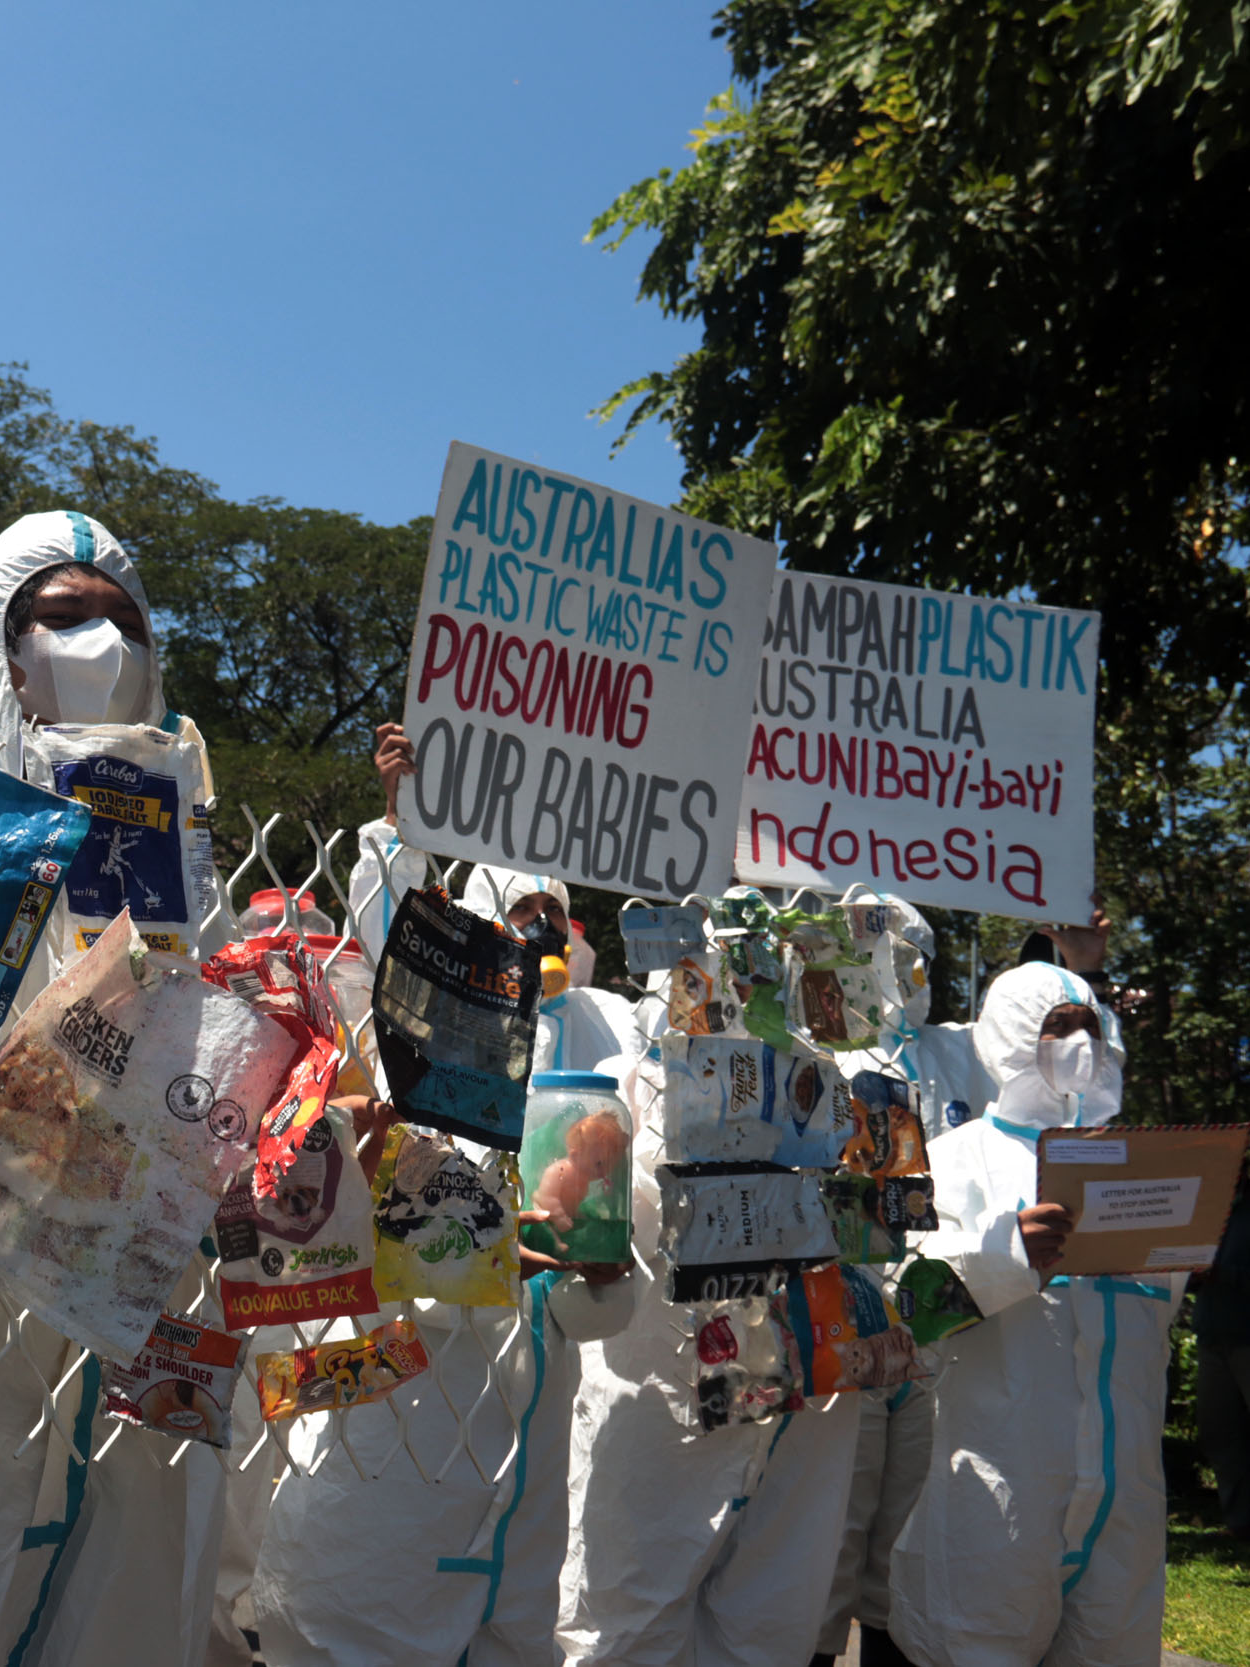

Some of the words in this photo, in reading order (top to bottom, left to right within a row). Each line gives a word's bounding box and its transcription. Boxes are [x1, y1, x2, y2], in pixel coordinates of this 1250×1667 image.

[453, 459, 734, 610] AUSTRALIA'S
[439, 540, 578, 634] PLASTIC
[586, 579, 687, 665] WASTE
[694, 620, 733, 677] IS
[917, 598, 1092, 695] PLASTIK
[417, 614, 653, 749] POISONING
[752, 658, 986, 749] USTRALIA
[94, 758, 138, 784] Cerebos
[748, 723, 869, 798] ACUNI
[88, 789, 145, 813] IODISED
[416, 717, 526, 861] OUR
[525, 748, 718, 898] BABIES
[42, 862, 59, 882] 60
[400, 920, 522, 999] SavourLife
[71, 996, 135, 1055] CHICKEN
[470, 989, 519, 1008] DIFFERENCE
[58, 1008, 129, 1076] TENDERS
[449, 1068, 489, 1087] FLAVOUR
[730, 1050, 746, 1113] Fancy
[745, 1052, 759, 1103] Feast
[741, 1189, 753, 1246] MEDIUM
[1101, 1187, 1127, 1198] LETTER
[1128, 1186, 1142, 1196] FOR
[1144, 1184, 1181, 1195] AUSTRALIA
[262, 1290, 313, 1316] VALUE
[317, 1285, 359, 1306] PACK
[153, 1318, 201, 1349] HOTHANDS
[144, 1355, 152, 1368] &
[155, 1356, 214, 1387] SHOULDER
